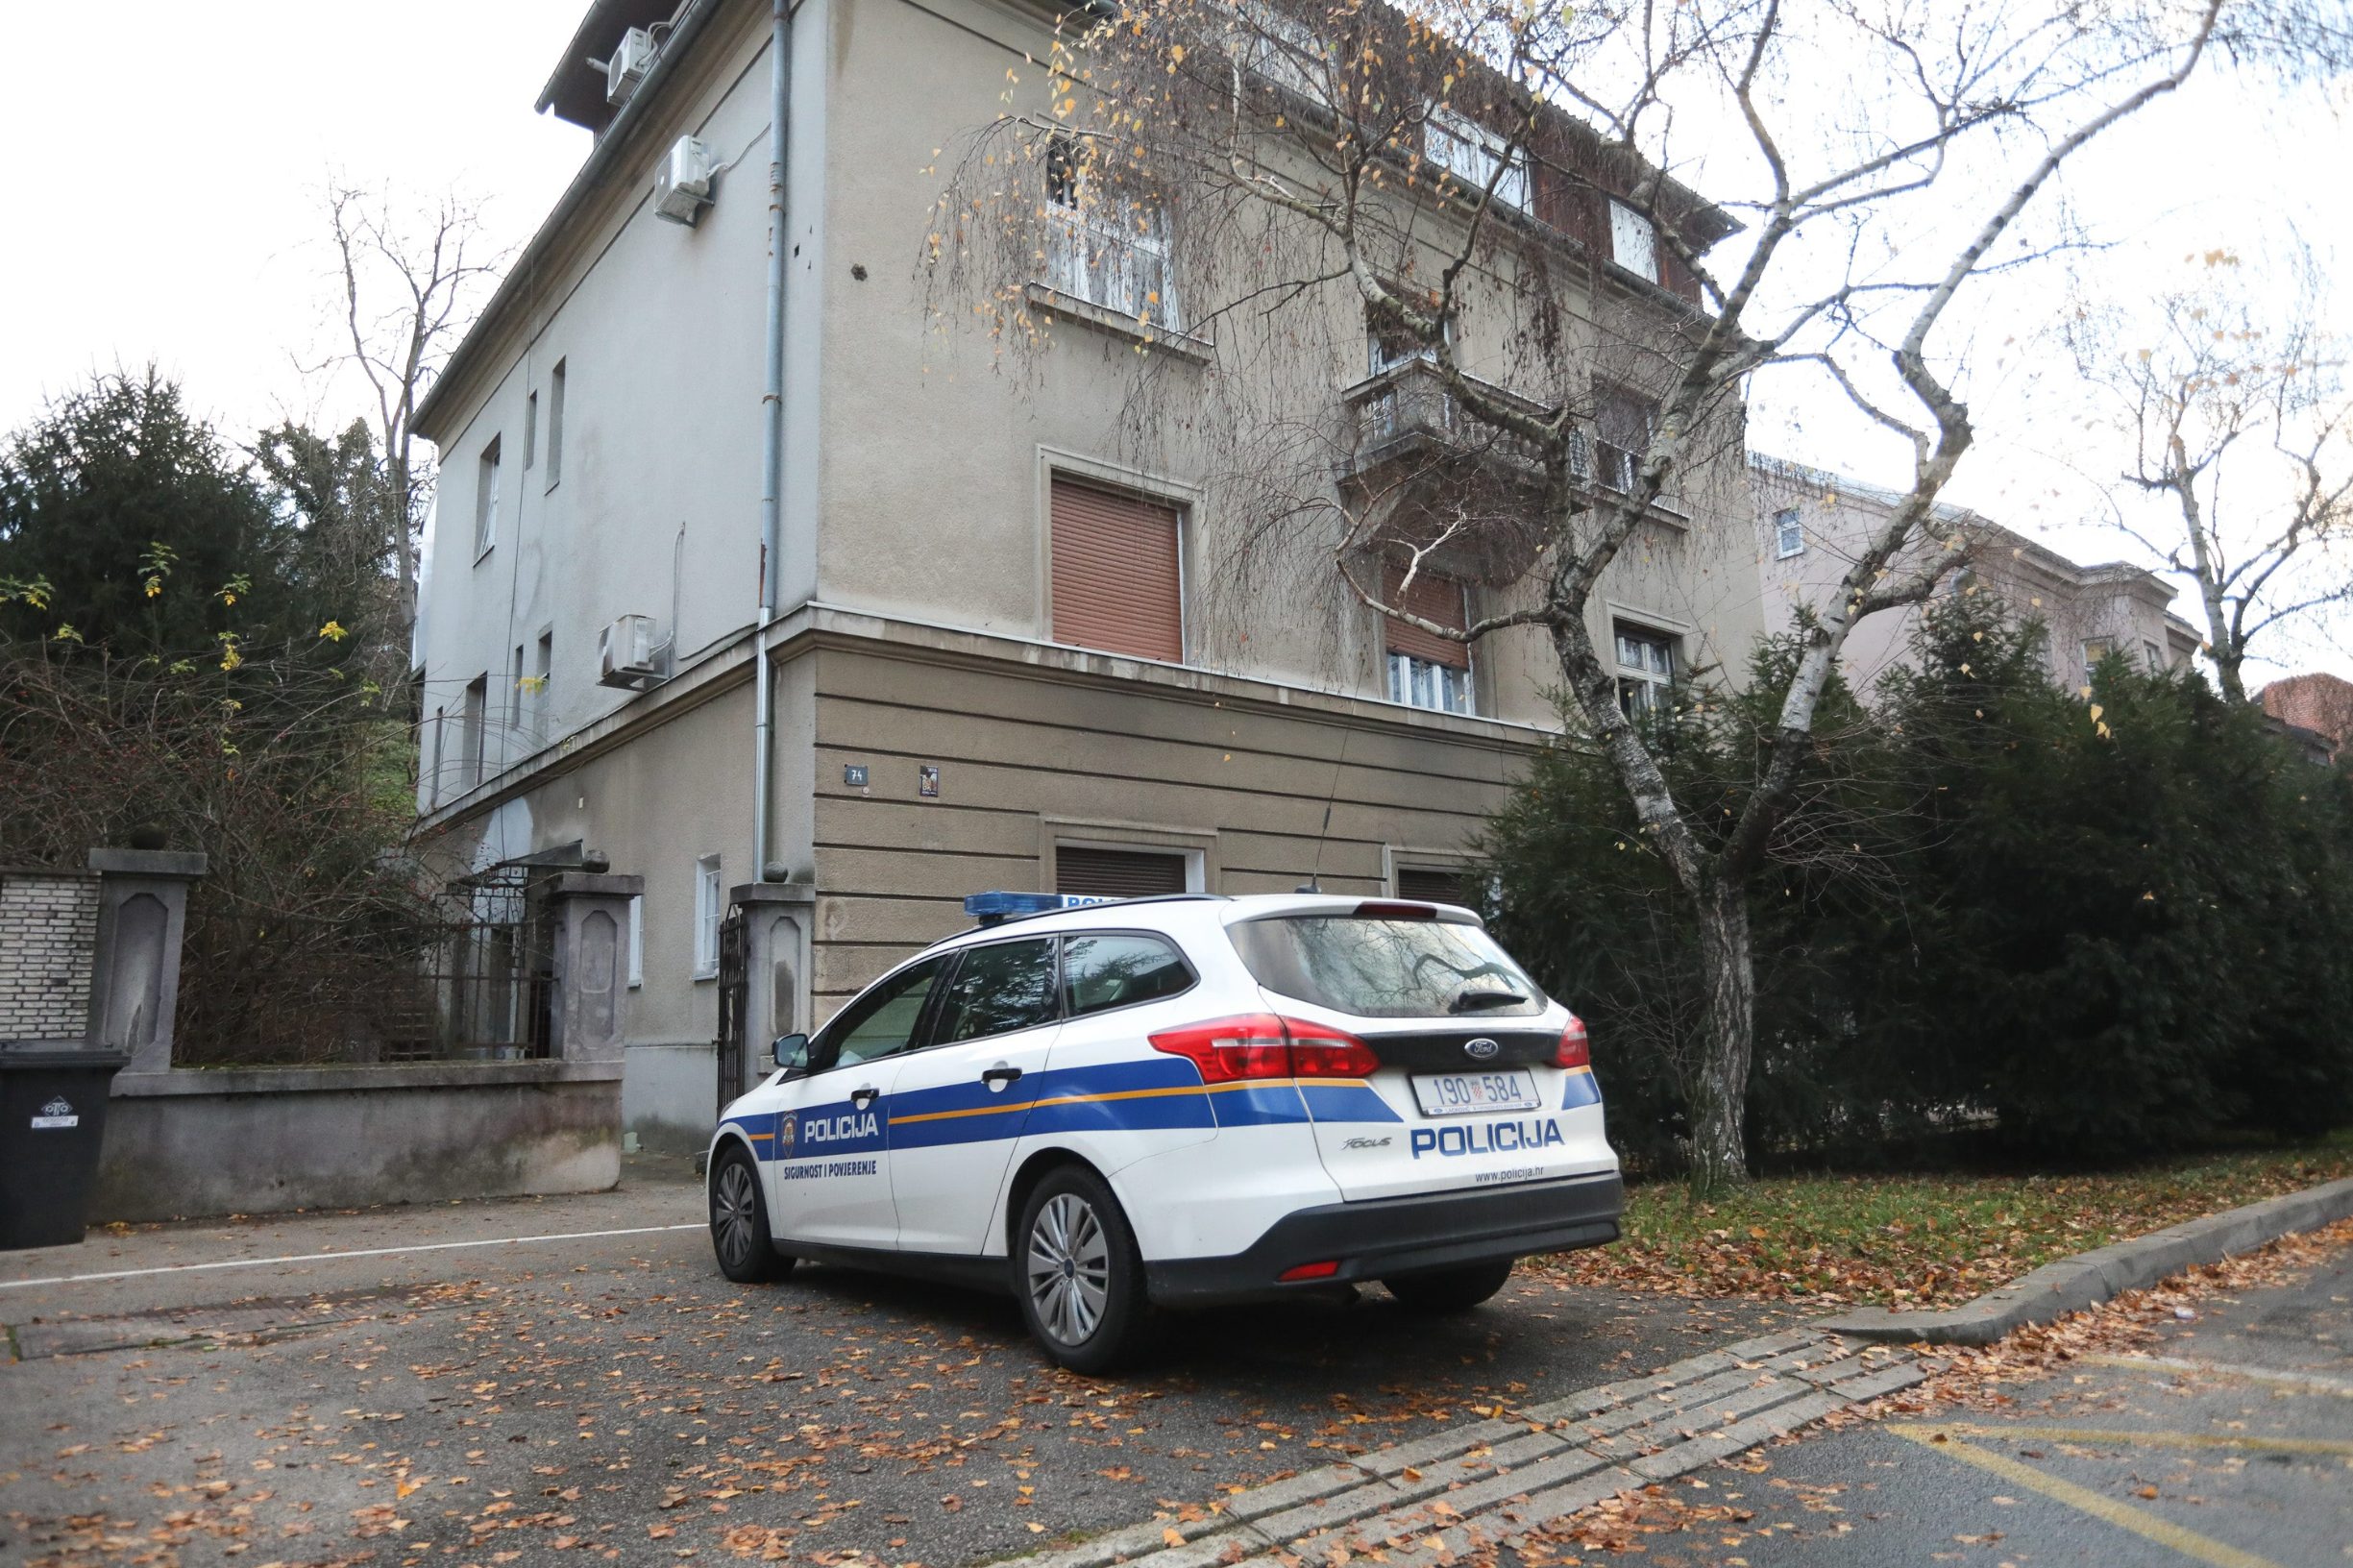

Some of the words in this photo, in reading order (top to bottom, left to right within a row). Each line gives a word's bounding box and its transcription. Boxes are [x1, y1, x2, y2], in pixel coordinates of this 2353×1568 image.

[851, 770, 863, 781] 74
[1474, 1041, 1492, 1054] Ford
[1434, 1077, 1471, 1105] 190
[1482, 1075, 1522, 1102] 584
[805, 1113, 878, 1143] POLICIJA
[1410, 1118, 1565, 1160] POLICIJA
[784, 1164, 823, 1180] SIGURNOST
[828, 1160, 877, 1177] POVJERENJE
[1475, 1165, 1544, 1183] www.policija.hr
